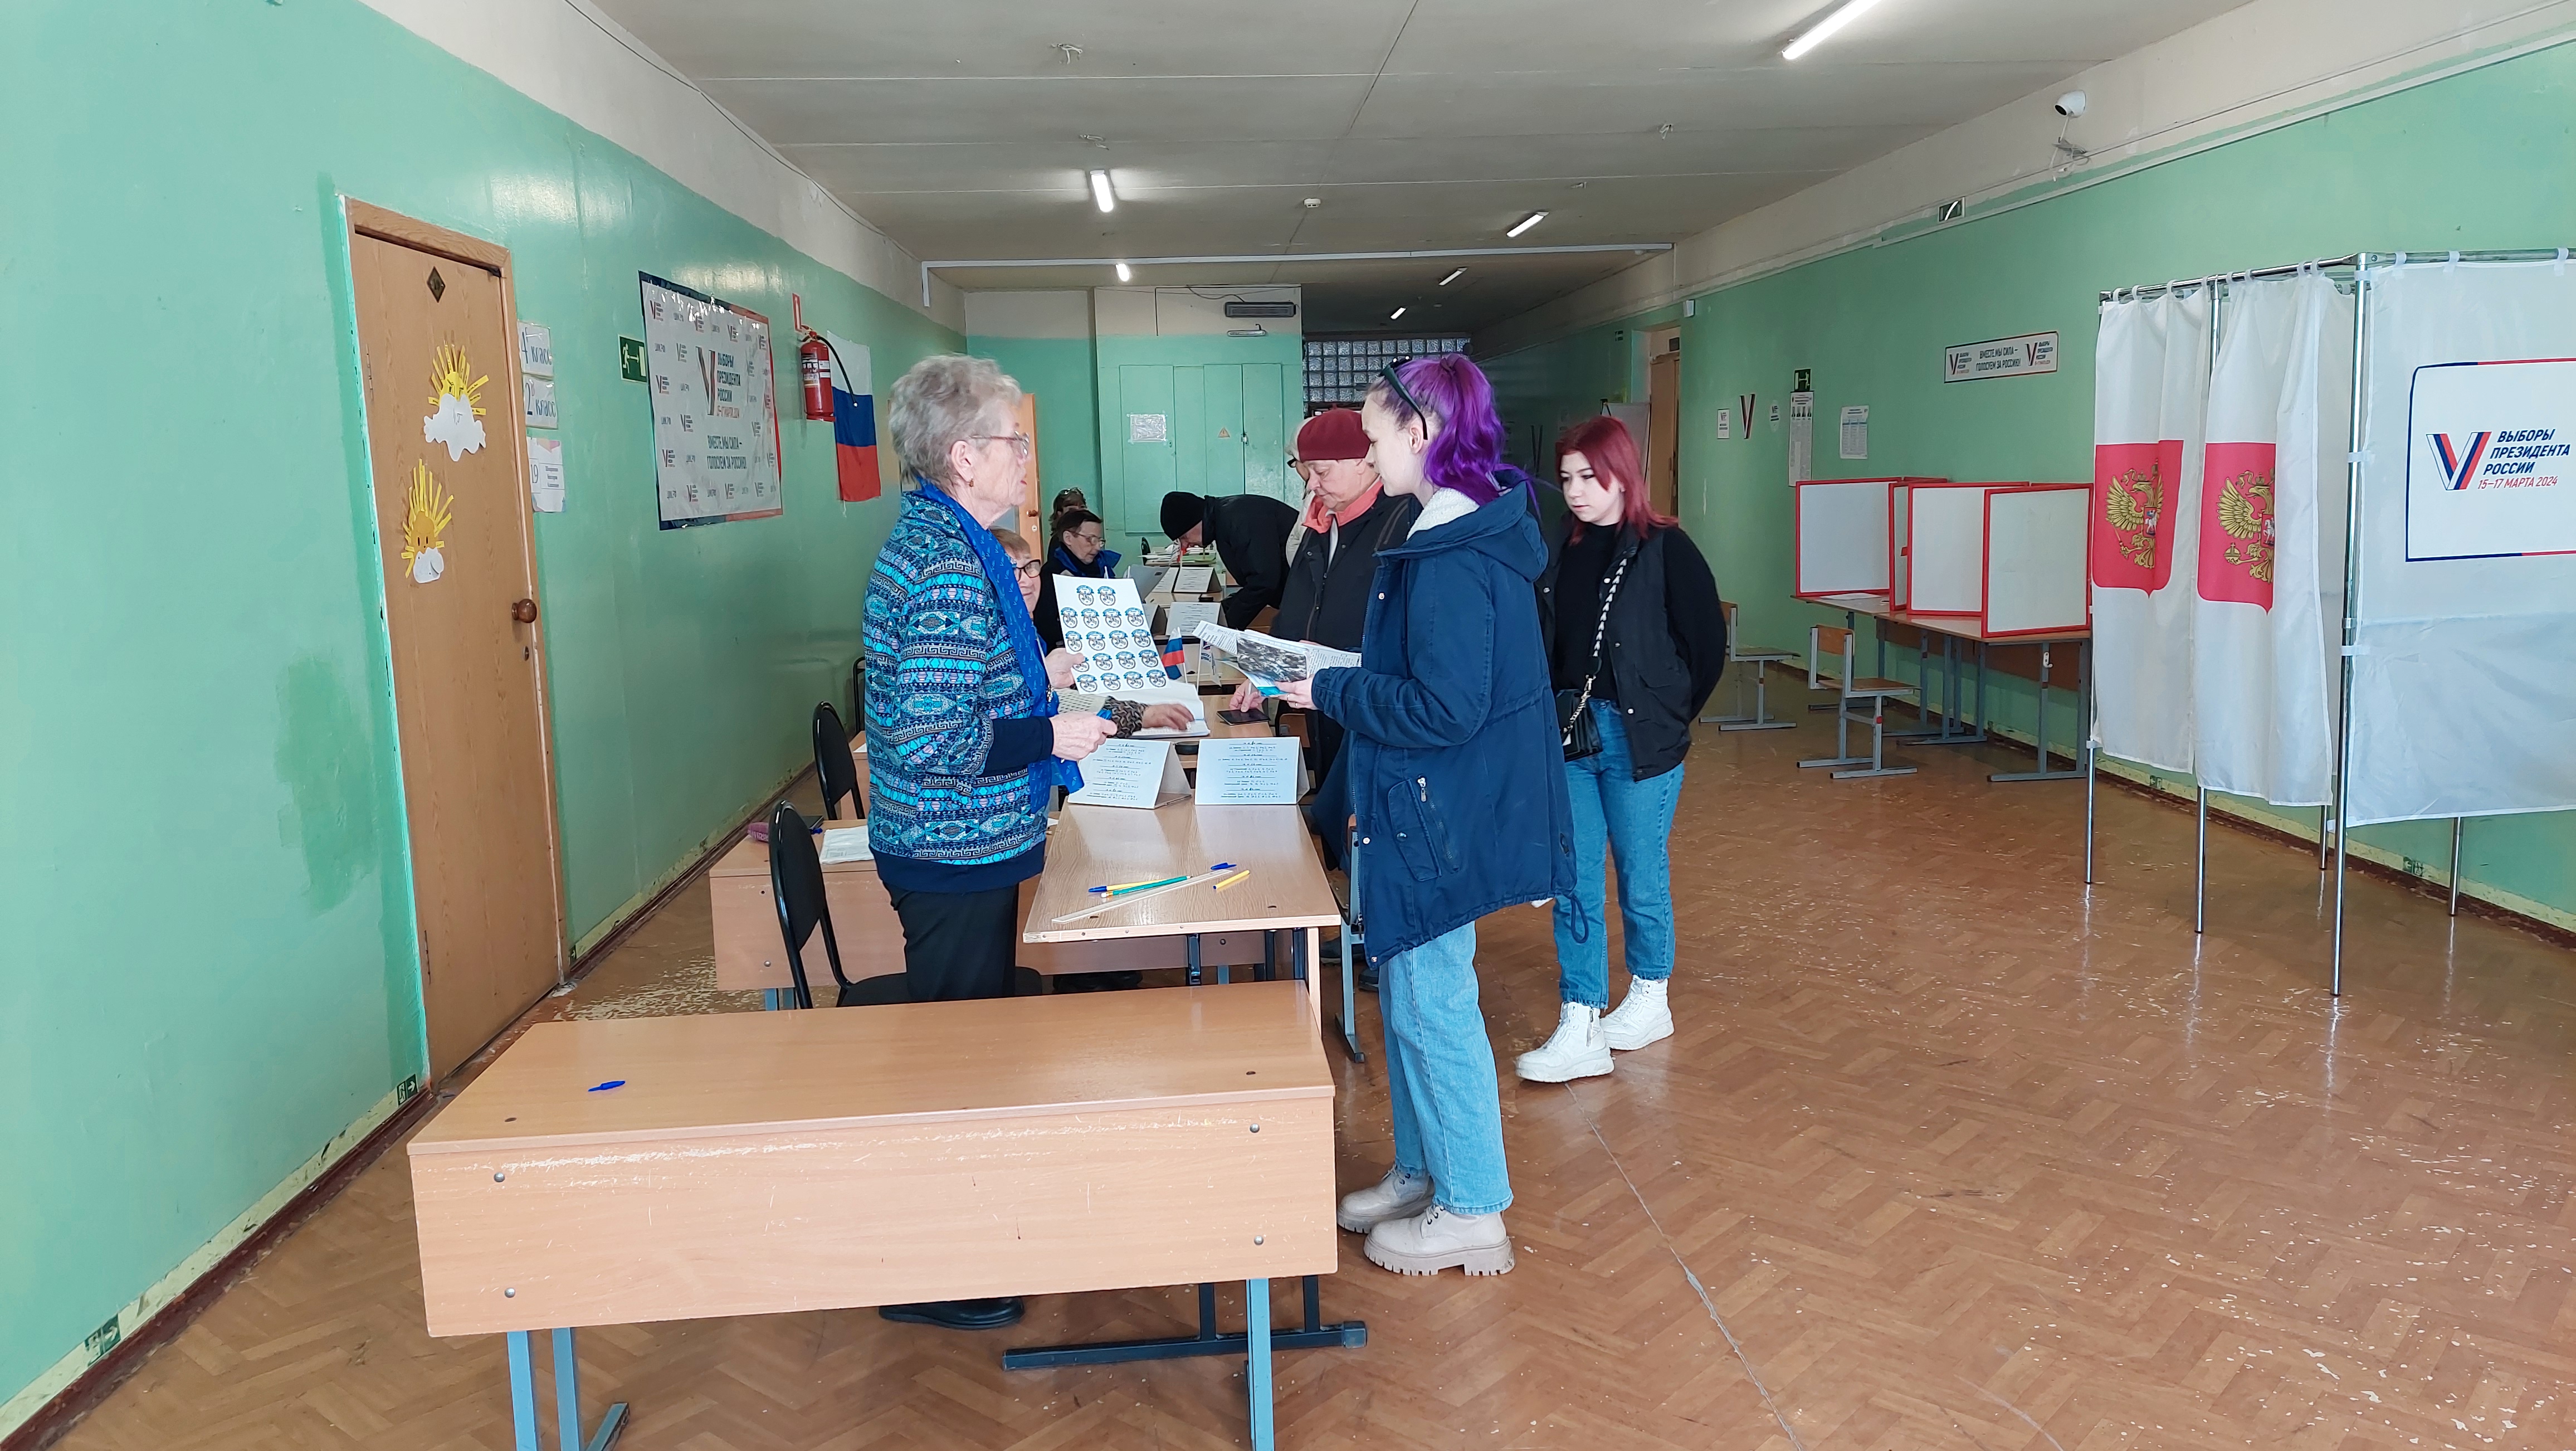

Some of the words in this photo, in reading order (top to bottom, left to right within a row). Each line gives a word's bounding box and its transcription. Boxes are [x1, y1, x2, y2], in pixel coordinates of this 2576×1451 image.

[2497, 429, 2556, 442] ВЫБОРЫ
[2490, 444, 2571, 459] ПРЕЗИДЕНТА
[531, 464, 538, 483] 19
[2483, 461, 2536, 475] РОССИИ
[2504, 477, 2535, 489] МАРТА
[2535, 476, 2558, 486] 2024
